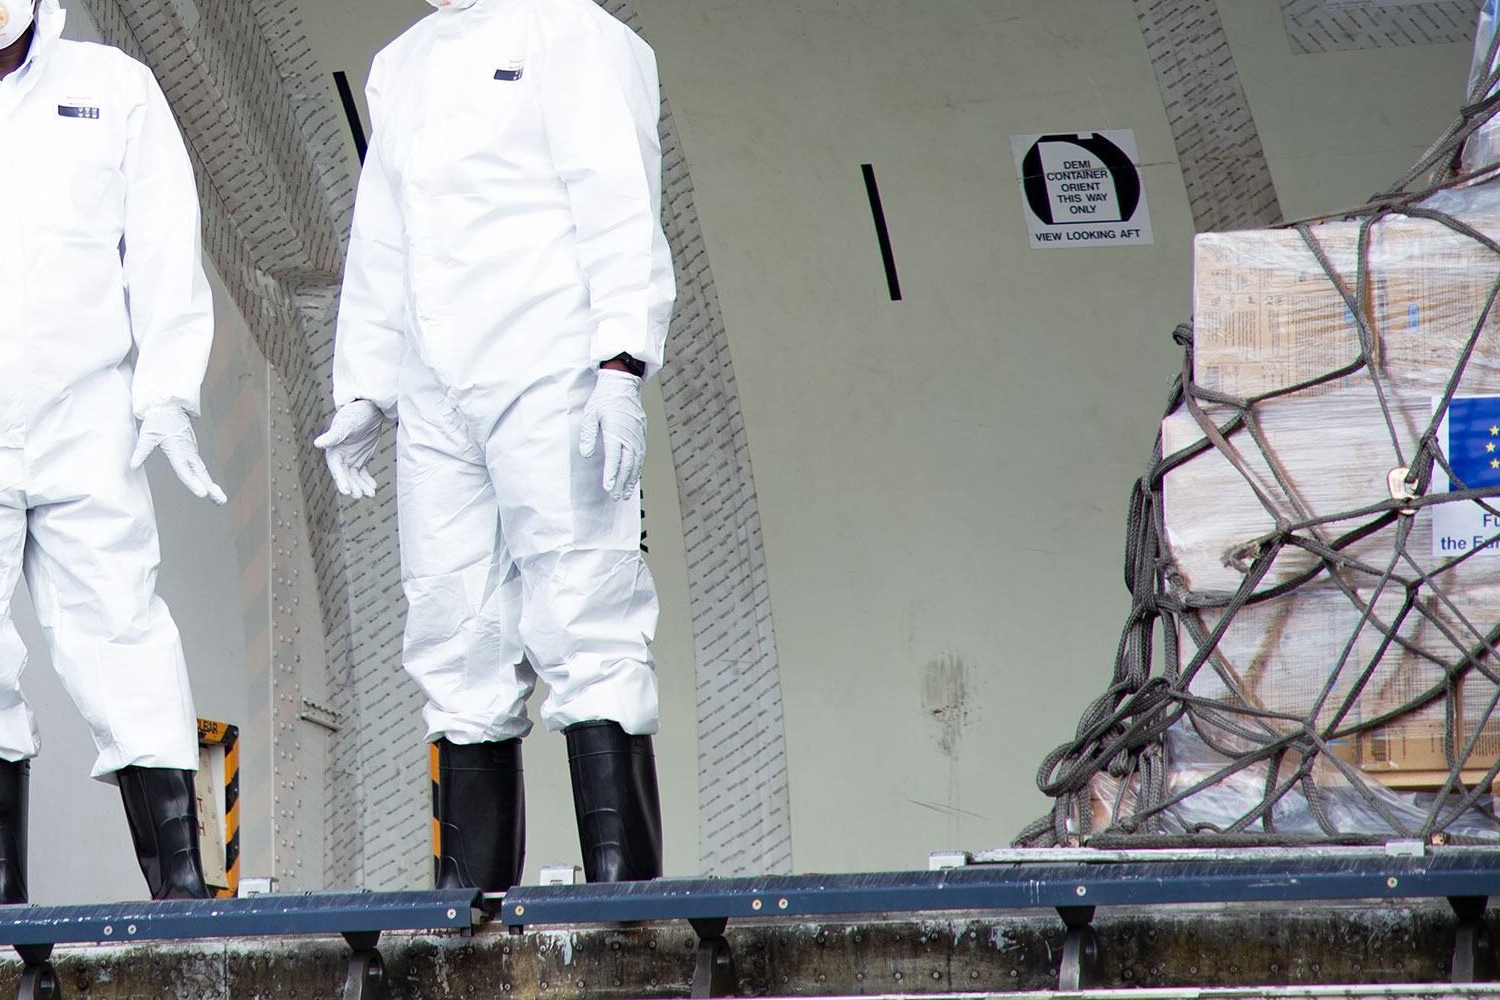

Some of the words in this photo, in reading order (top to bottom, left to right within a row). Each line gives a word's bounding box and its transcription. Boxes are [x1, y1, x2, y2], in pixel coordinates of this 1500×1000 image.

[1063, 160, 1091, 170] DEMI
[1046, 170, 1109, 181] CONTAINER
[1061, 182, 1101, 192] ORIENT
[1057, 194, 1082, 203] THIS
[1086, 193, 1108, 202] WAY
[1069, 205, 1097, 215] ONLY
[1035, 232, 1063, 242] VIEW
[1066, 230, 1116, 241] LOOKING
[1120, 229, 1141, 239] AFT
[1441, 535, 1467, 550] the
